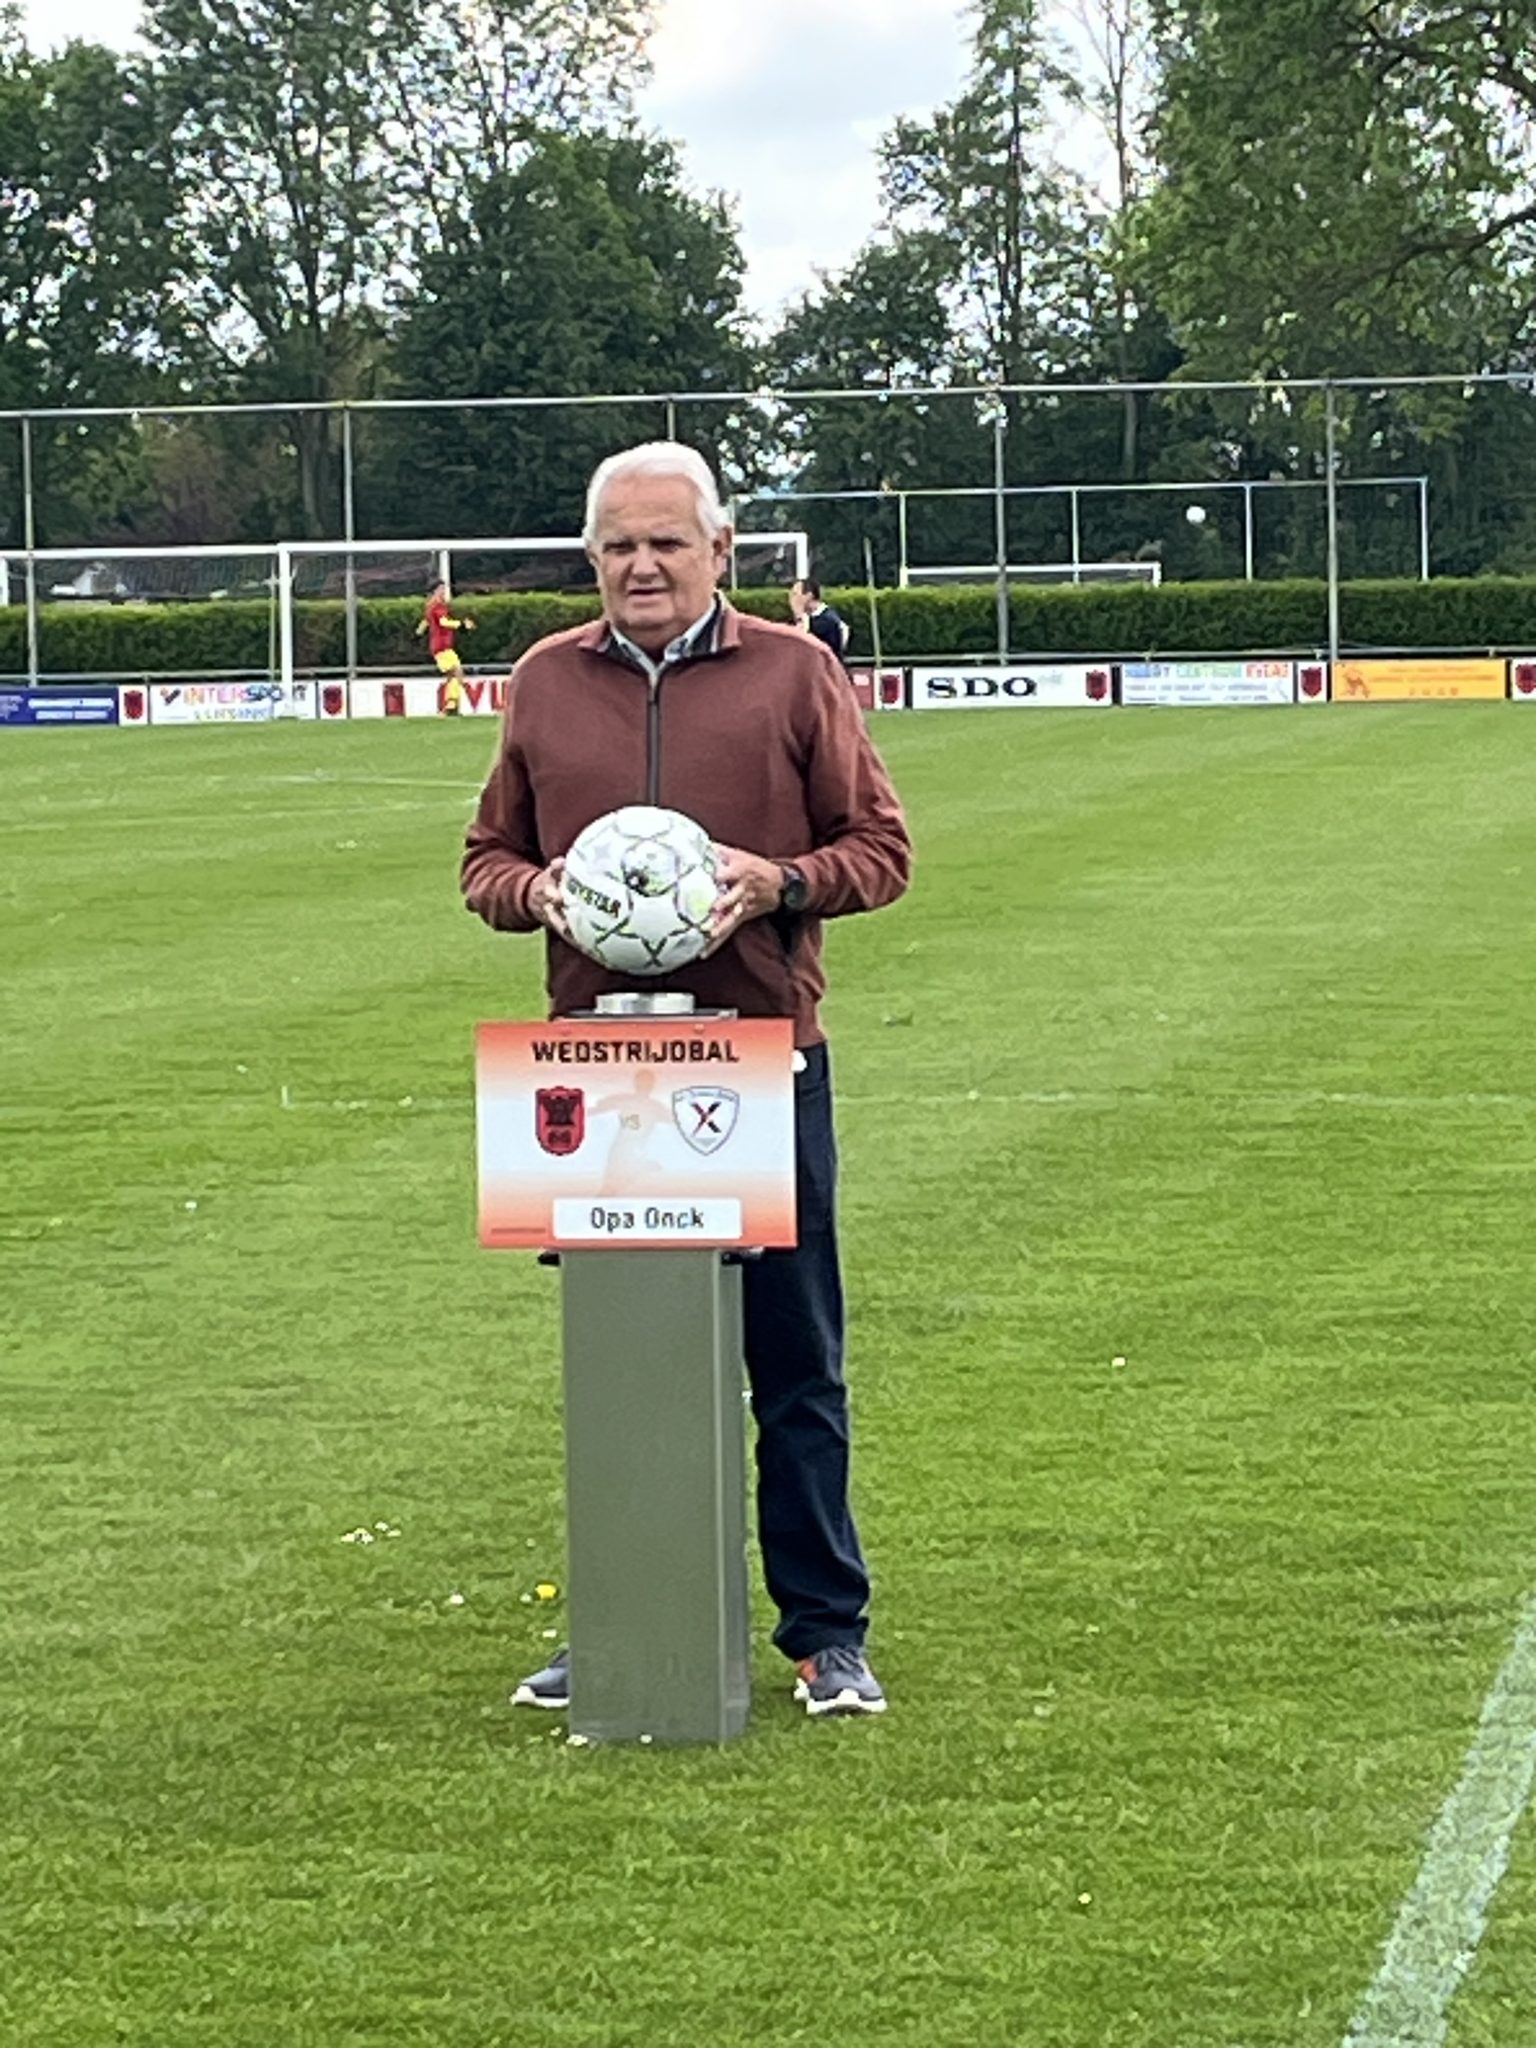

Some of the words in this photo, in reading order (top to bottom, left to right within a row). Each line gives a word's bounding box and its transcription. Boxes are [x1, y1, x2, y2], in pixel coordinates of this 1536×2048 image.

[184, 684, 308, 706] INTERSPOT
[925, 676, 1038, 699] SDO
[591, 1206, 635, 1232] Opa
[644, 1206, 704, 1229] Onck
